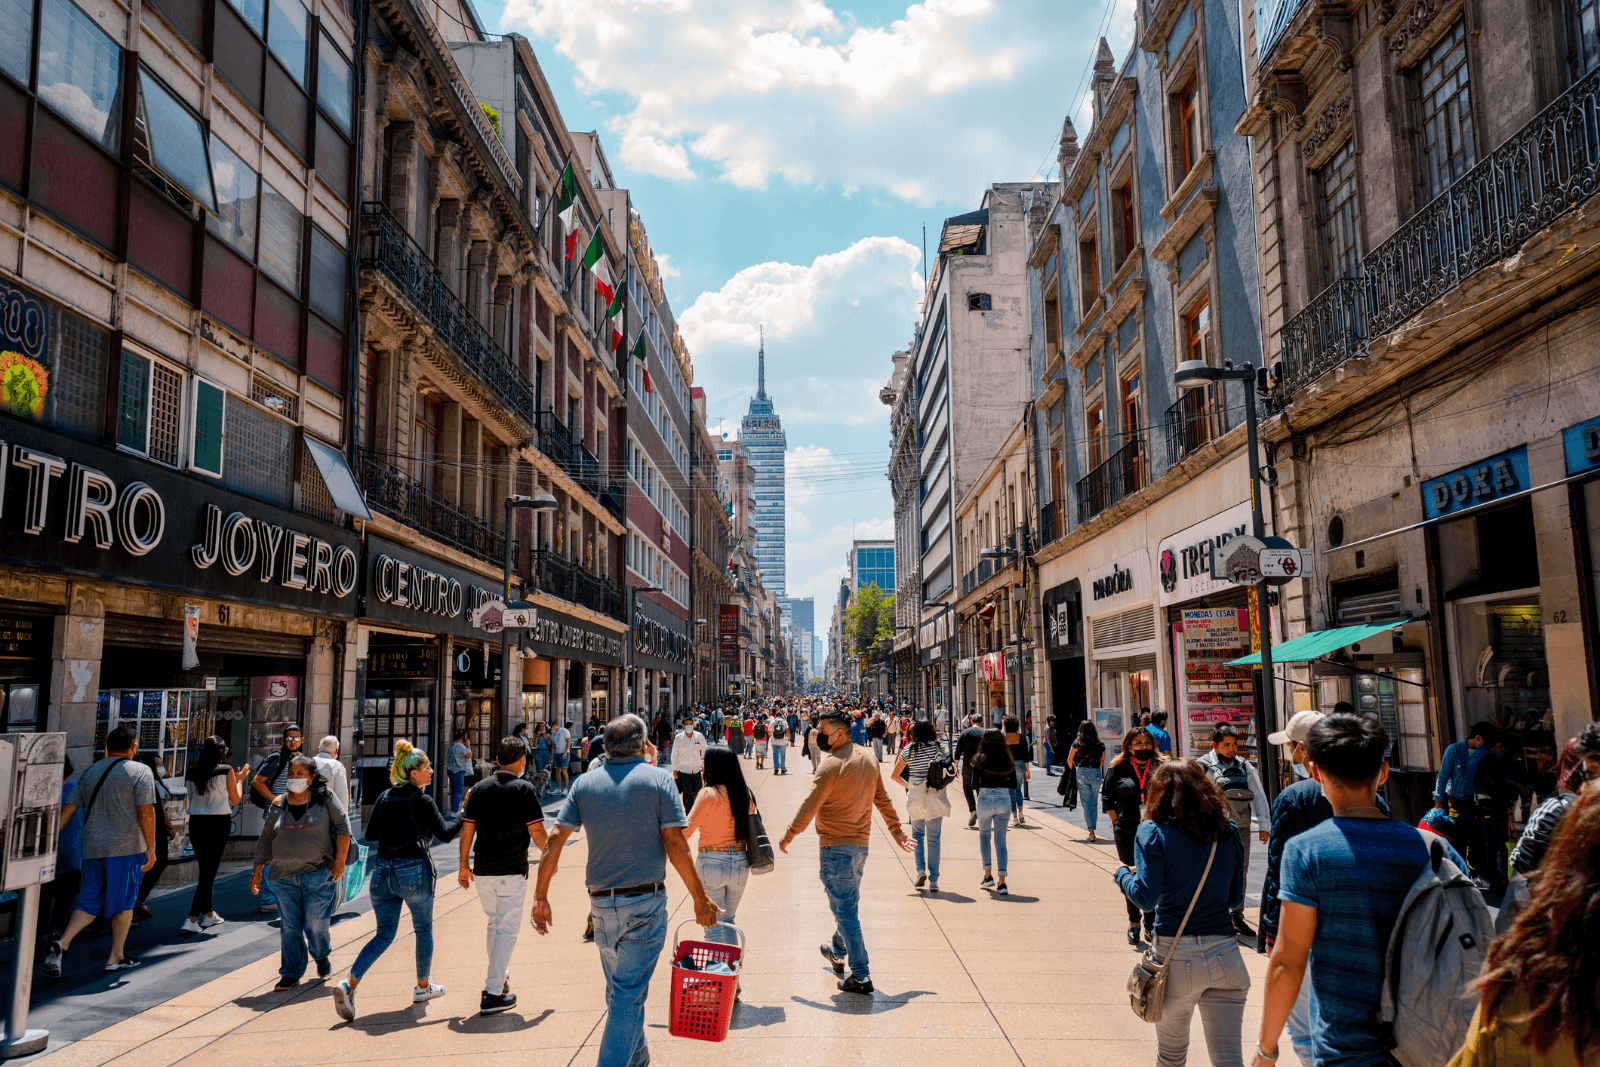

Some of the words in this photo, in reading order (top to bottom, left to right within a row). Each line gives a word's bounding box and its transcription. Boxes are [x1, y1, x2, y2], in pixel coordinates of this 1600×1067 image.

[1431, 459, 1518, 509] DOXA
[0, 439, 165, 556] TRO
[191, 503, 359, 598] JOYERO
[375, 553, 462, 618] CENTRO
[218, 605, 230, 624] 61
[1184, 610, 1213, 618] MONEDAS
[1216, 609, 1236, 617] CESAR
[1211, 617, 1236, 627] ORO
[1553, 610, 1567, 623] 62
[635, 611, 669, 659] CENTRO
[1184, 629, 1207, 638] PLATA
